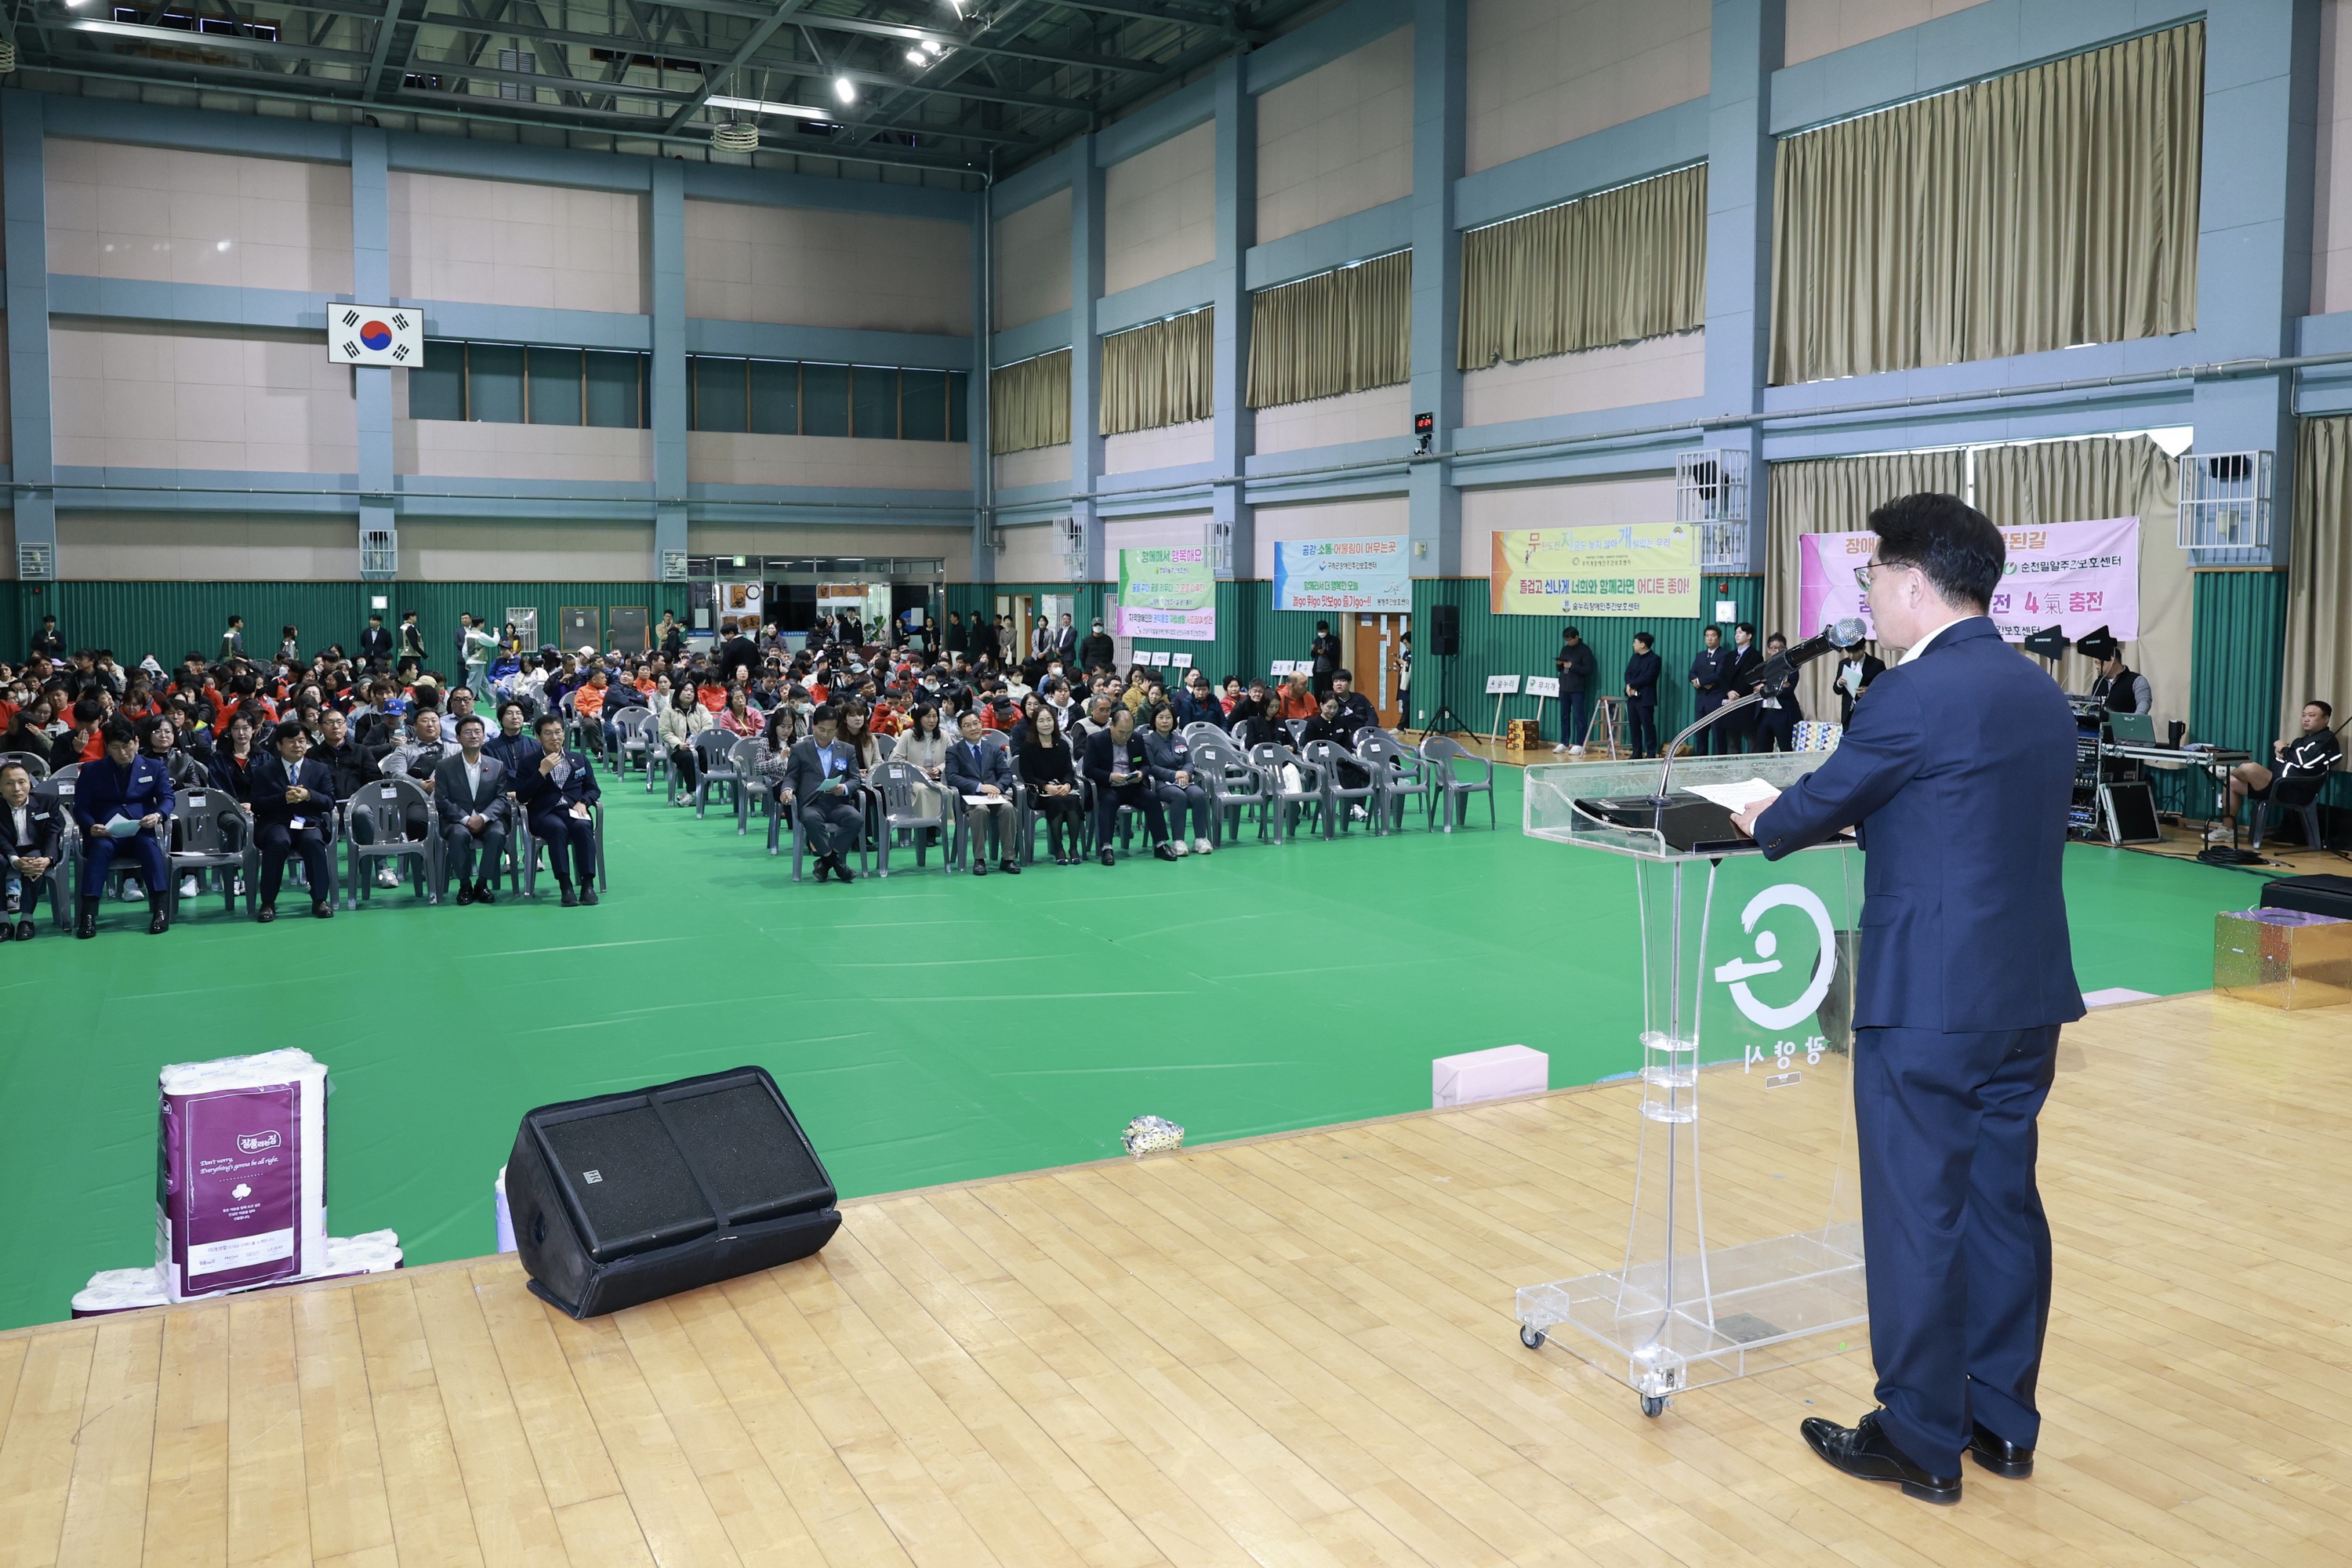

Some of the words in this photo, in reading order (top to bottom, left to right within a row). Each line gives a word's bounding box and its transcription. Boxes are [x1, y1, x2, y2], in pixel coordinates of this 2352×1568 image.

[1588, 540, 1601, 550] 늦지
[1603, 539, 1617, 550] 않아
[1656, 538, 1671, 549] 우리
[1845, 536, 1881, 554] 장애
[1142, 550, 1171, 564] 함께해서
[2021, 555, 2122, 575] 순천밀알주간보호센터
[1348, 580, 1359, 590] 오늘
[1519, 579, 1543, 594] 즐겁고
[1545, 579, 1570, 594] 신나게
[1571, 579, 1598, 594] 너희와
[1599, 578, 1635, 594] 함께라면
[1637, 578, 1664, 594] 어디든
[1668, 577, 1690, 594] 좋아!
[1573, 602, 1639, 612] 숲누리장애인주간보호센터
[2069, 591, 2104, 612] 충전
[1996, 626, 2041, 637] 간보호센터
[1497, 680, 1515, 688] 숲누리
[1538, 681, 1556, 691] 무지개
[240, 1134, 277, 1149] 잘풀리는집
[200, 1164, 234, 1174] Everything's
[234, 1162, 250, 1171] gonna
